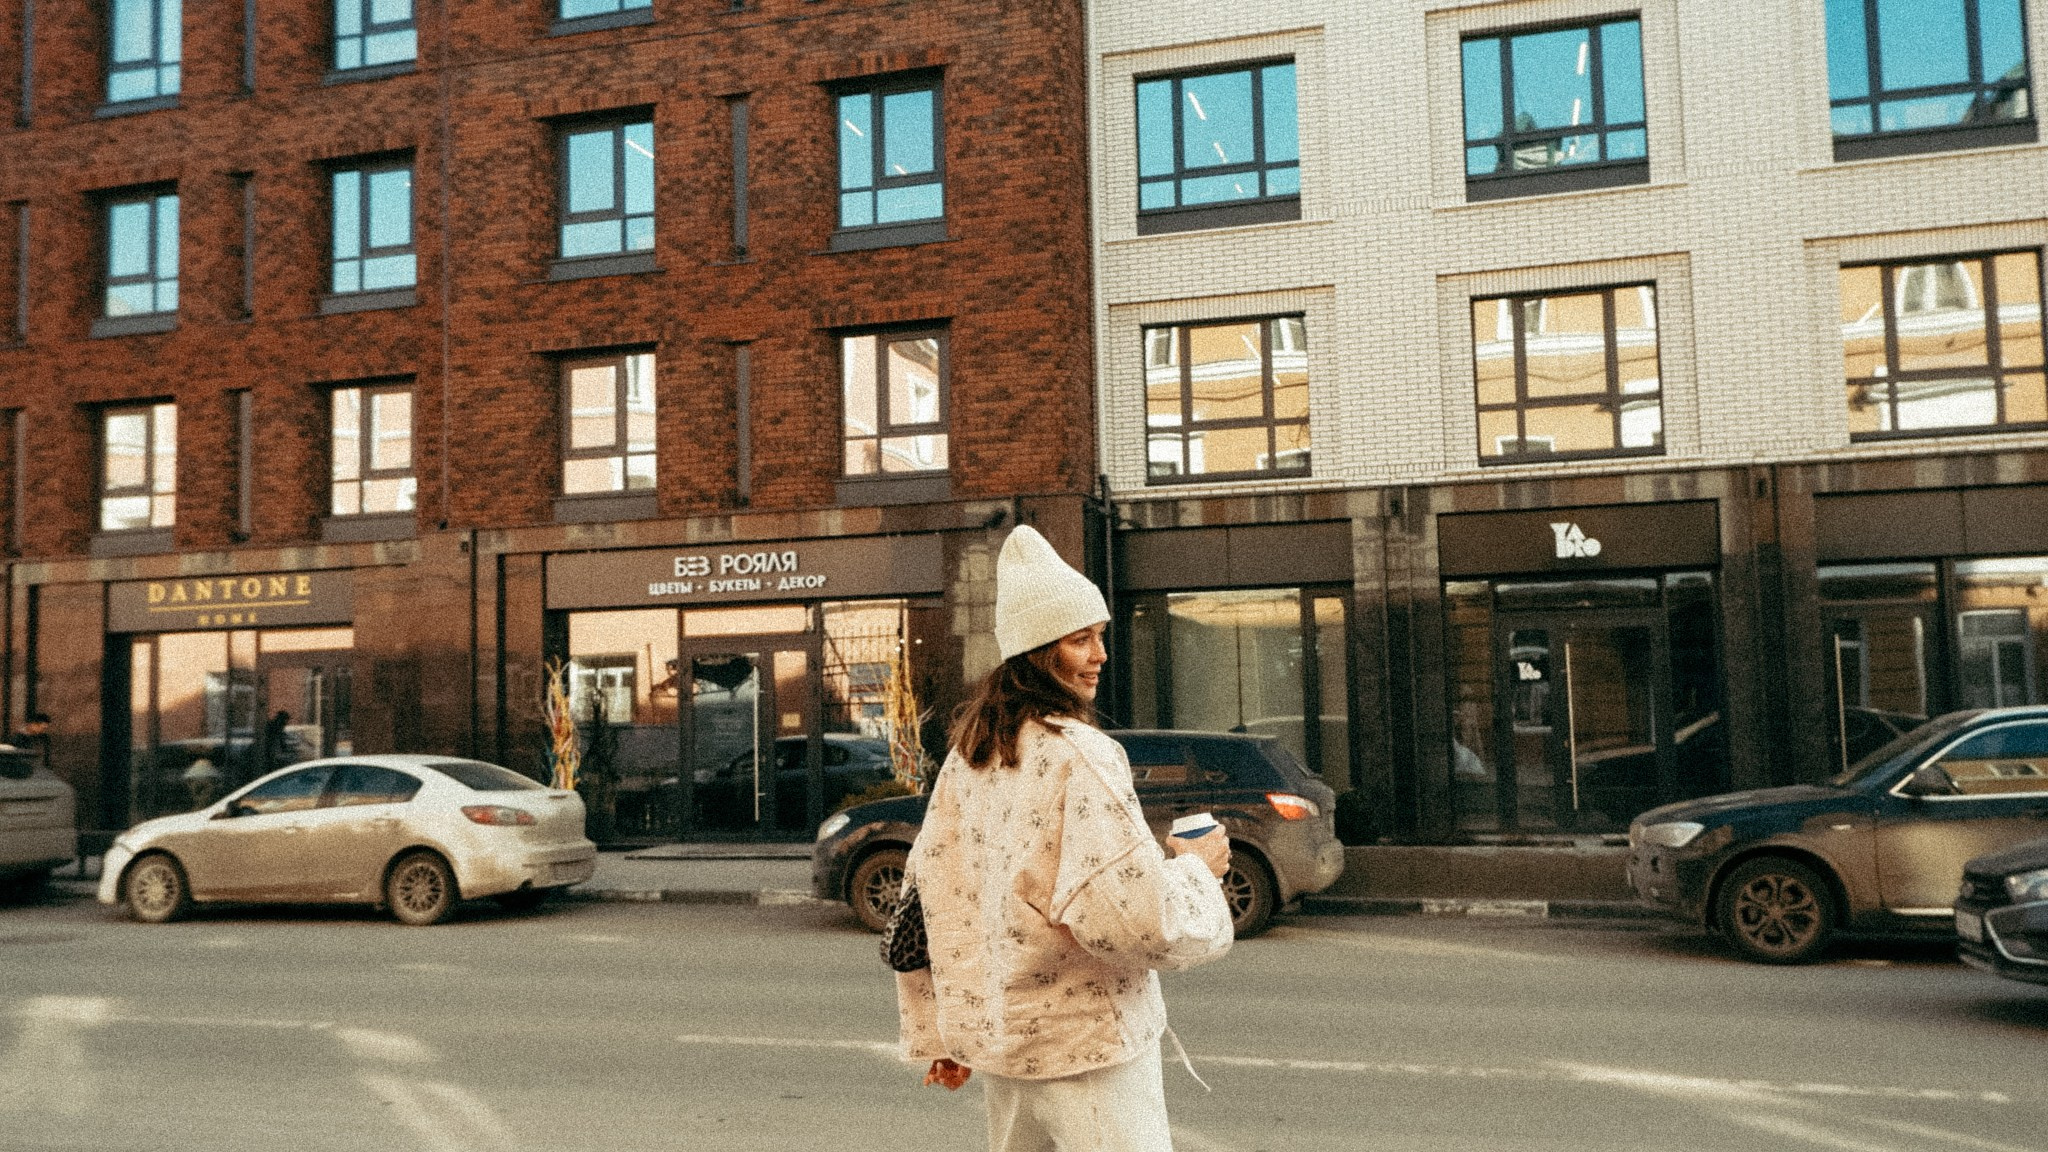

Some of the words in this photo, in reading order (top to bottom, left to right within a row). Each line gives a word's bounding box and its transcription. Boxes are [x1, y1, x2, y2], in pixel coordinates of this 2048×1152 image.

[674, 556, 711, 577] БЕЗ
[720, 551, 798, 575] РОЯЛЯ
[149, 575, 312, 603] DANTONE
[649, 581, 693, 596] ЦВЕТЫ
[709, 578, 762, 593] БУКЕТЫ
[778, 574, 827, 591] ДЕКОР
